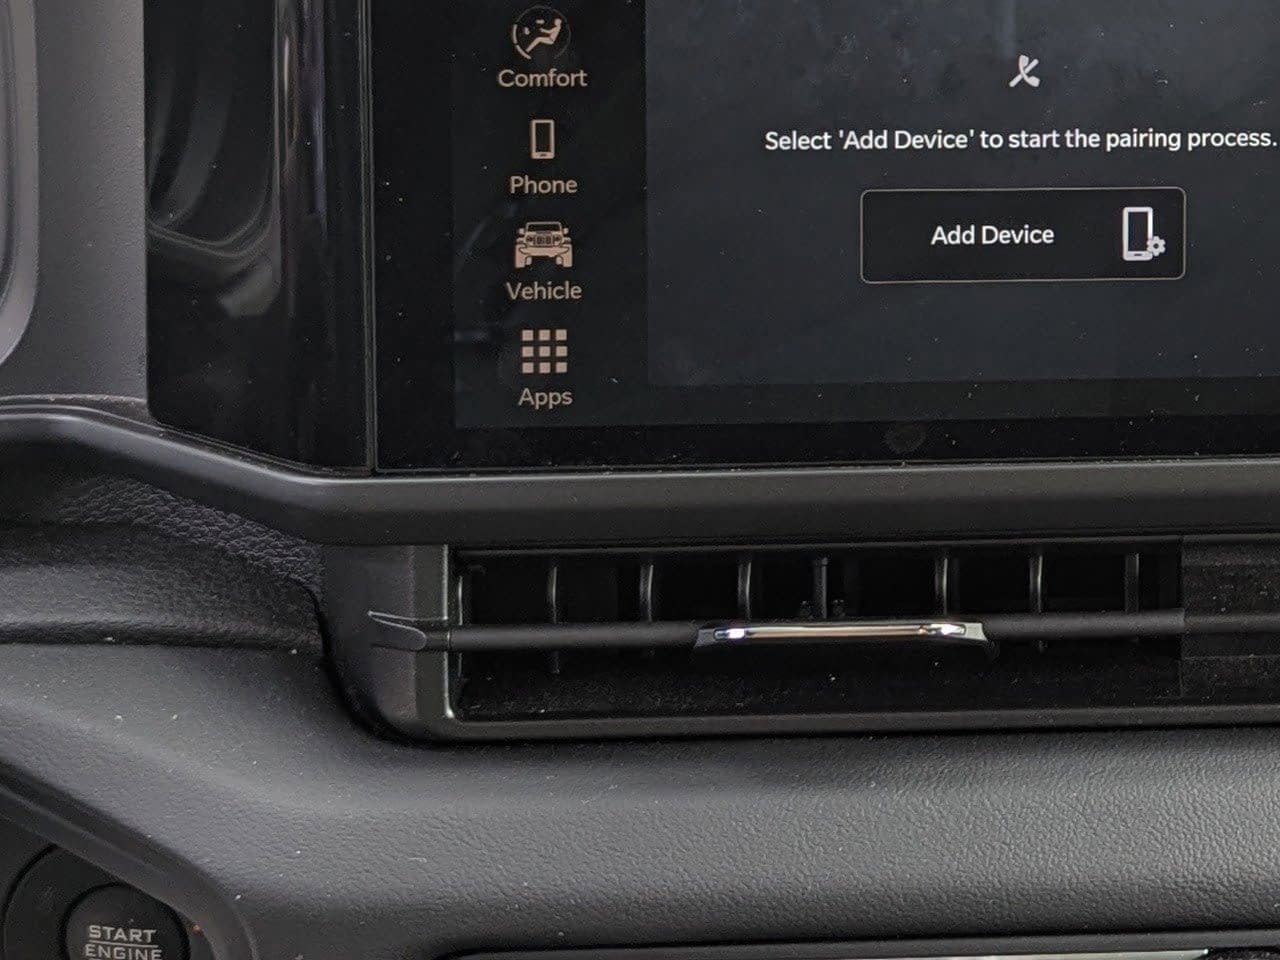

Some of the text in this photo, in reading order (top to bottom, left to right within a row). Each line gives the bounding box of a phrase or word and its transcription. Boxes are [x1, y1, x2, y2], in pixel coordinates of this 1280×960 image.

[498, 68, 587, 87] Comfort
[765, 130, 1277, 151] Select 'Add Device' to start the pairing process.
[510, 176, 577, 193] Phone
[931, 225, 1054, 244] Add Device
[507, 282, 582, 300] Vehicle
[519, 389, 572, 409] Apps
[89, 925, 156, 943] START
